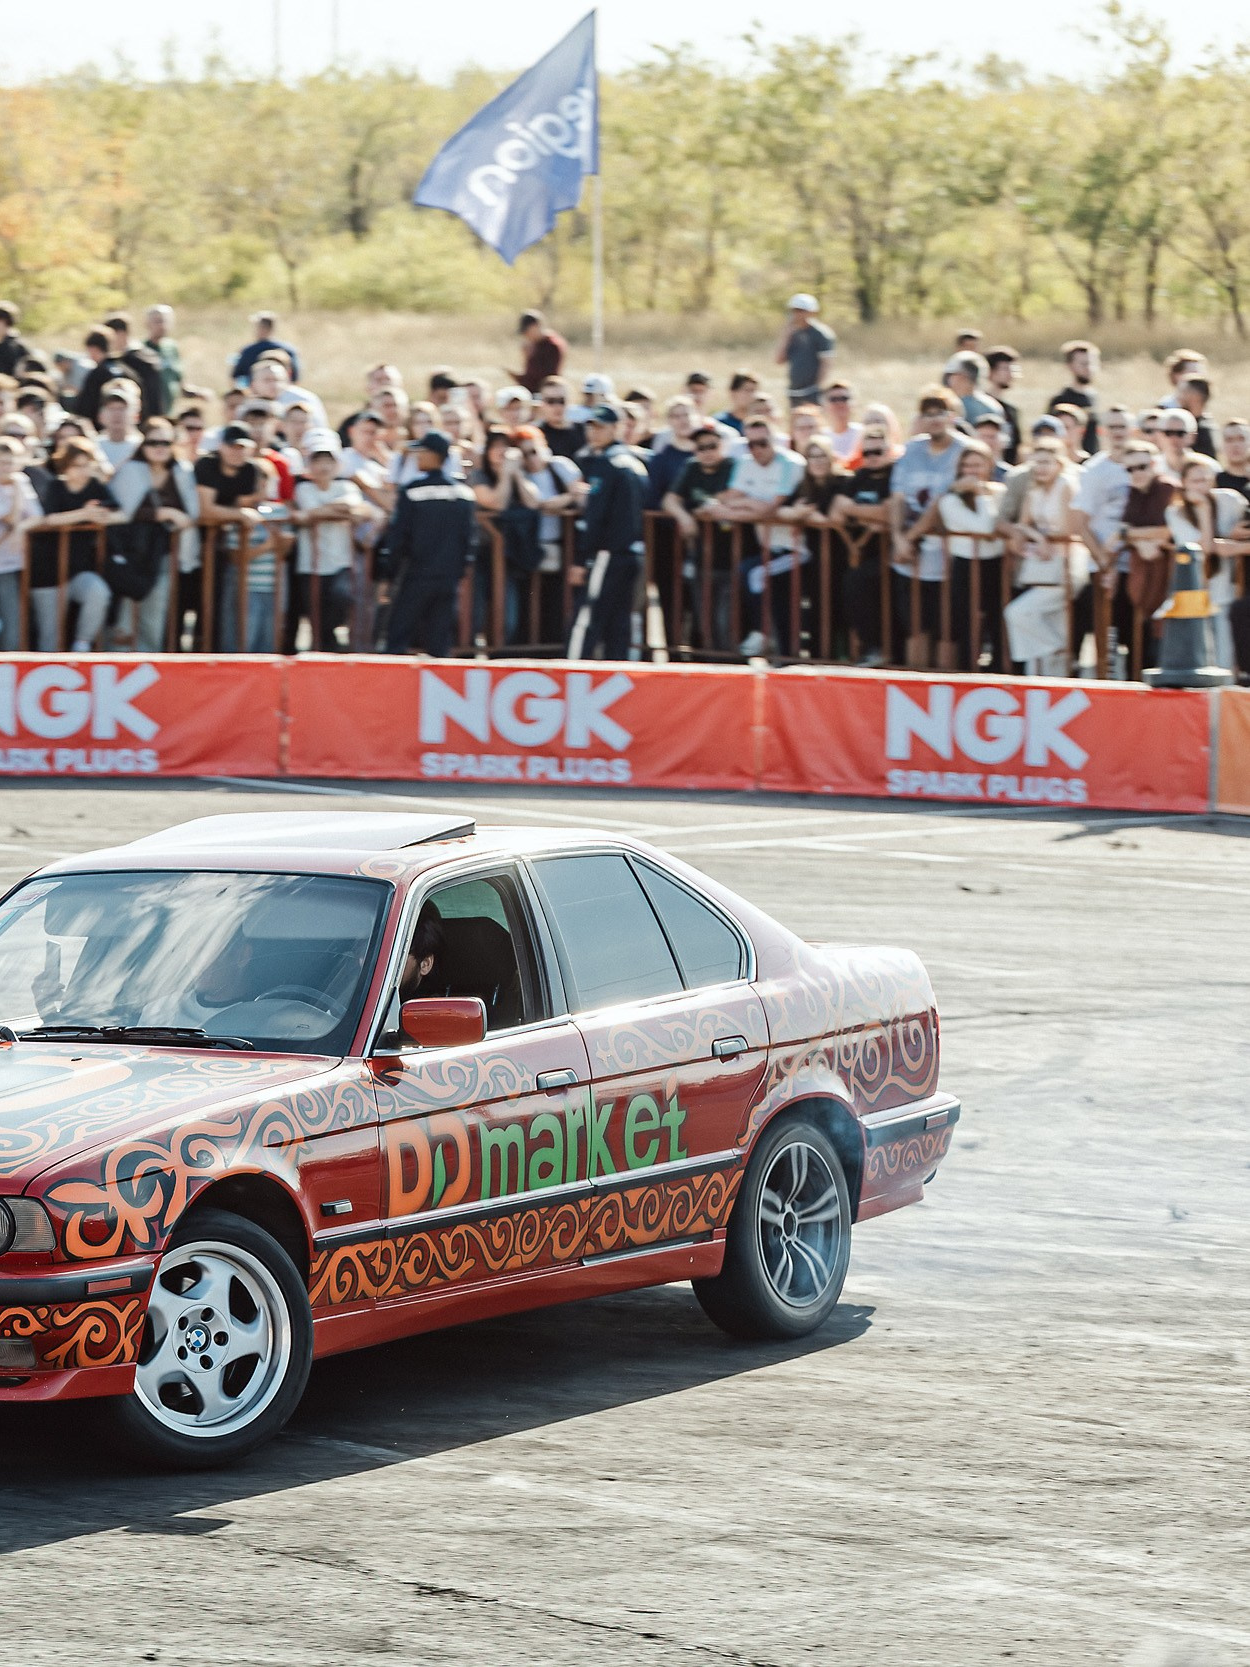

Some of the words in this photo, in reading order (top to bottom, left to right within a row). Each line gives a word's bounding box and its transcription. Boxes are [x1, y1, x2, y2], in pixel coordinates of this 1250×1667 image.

[419, 669, 634, 751] NGK
[885, 684, 1091, 770] NGK
[53, 748, 159, 772] PLUGS
[420, 752, 523, 779] SPARK
[526, 756, 632, 783] PLUGS
[887, 769, 984, 798] SPARK
[987, 774, 1088, 803] PLUGS
